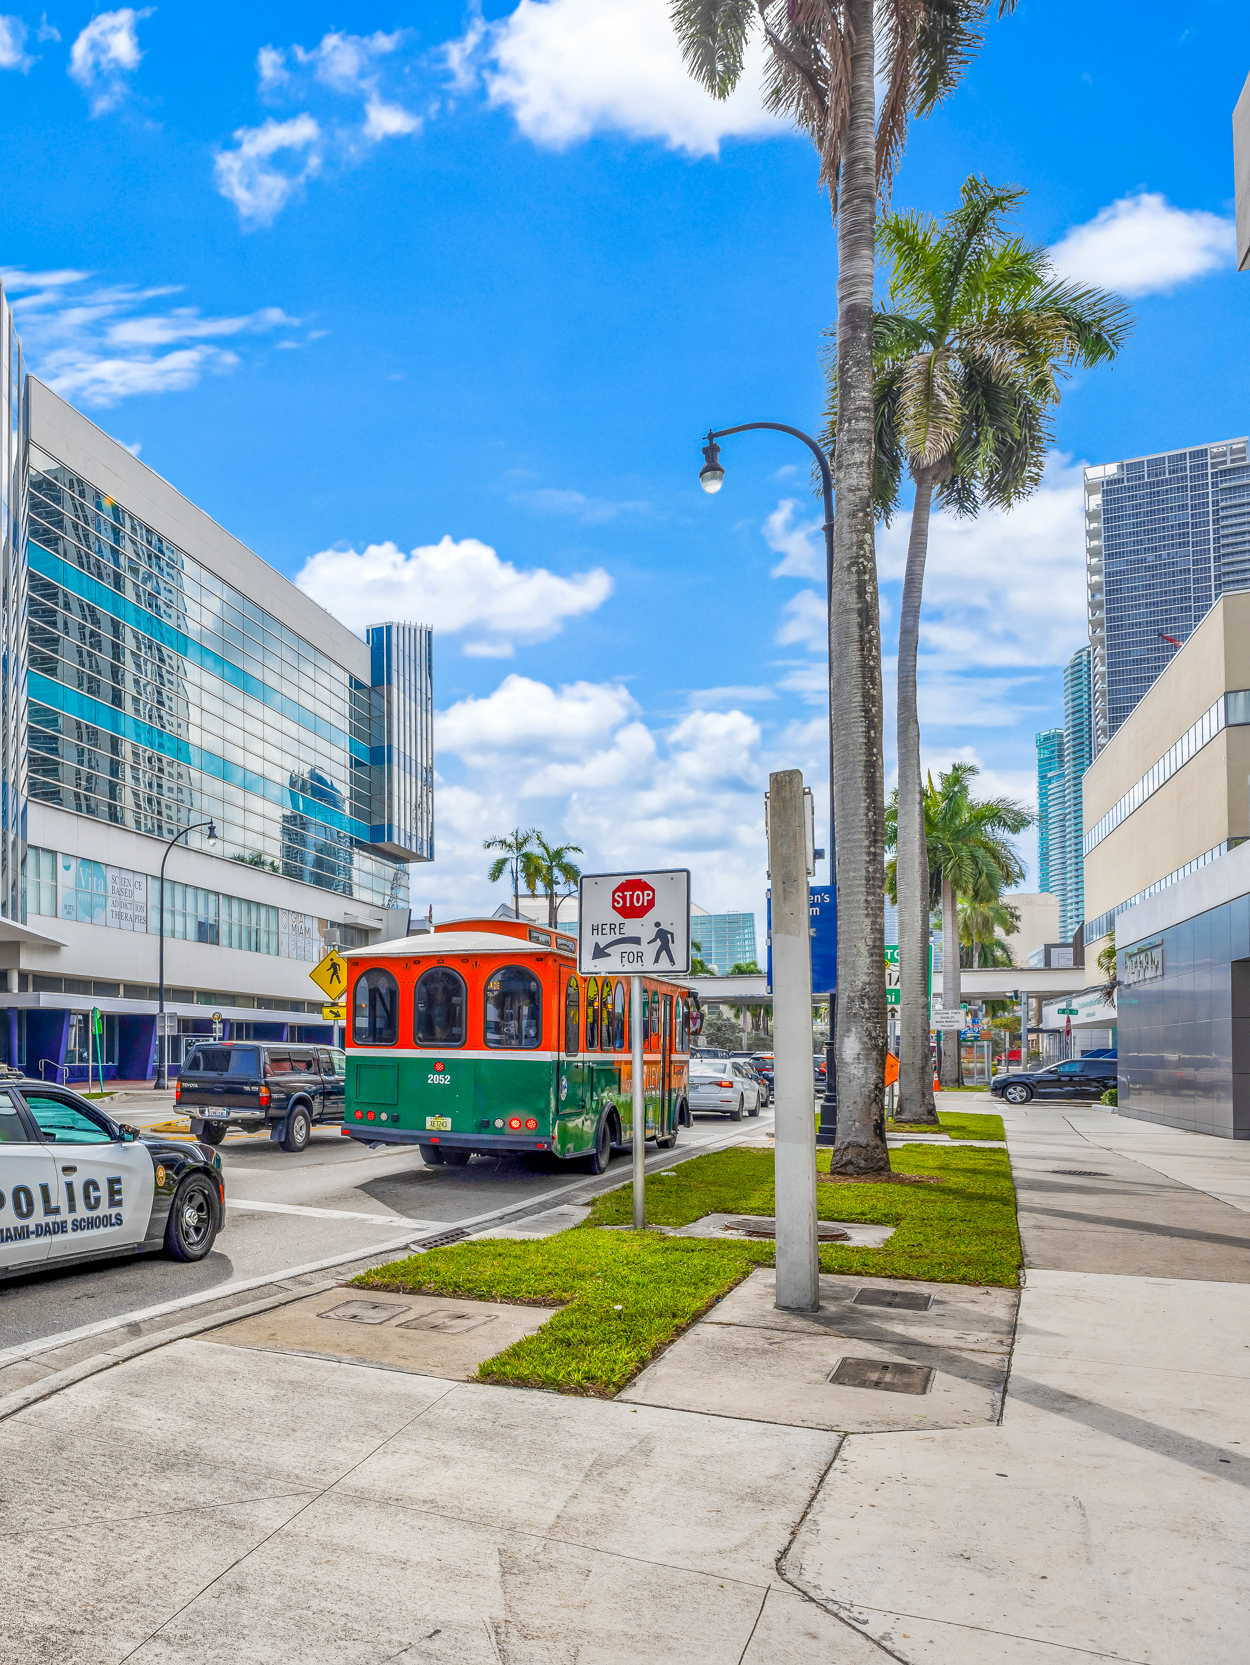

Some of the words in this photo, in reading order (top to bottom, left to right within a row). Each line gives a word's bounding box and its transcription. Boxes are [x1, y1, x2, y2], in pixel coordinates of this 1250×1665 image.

[78, 867, 104, 893] Vita
[111, 874, 142, 891] SCIENCE
[111, 885, 133, 899] BASED
[614, 890, 654, 908] STOP
[110, 900, 145, 913] ADDICTION
[110, 910, 146, 924] THERAPIES
[592, 922, 626, 936] HERE
[620, 951, 644, 964] FOR
[428, 1074, 450, 1084] 2052
[70, 1212, 124, 1232] SCHOOLS
